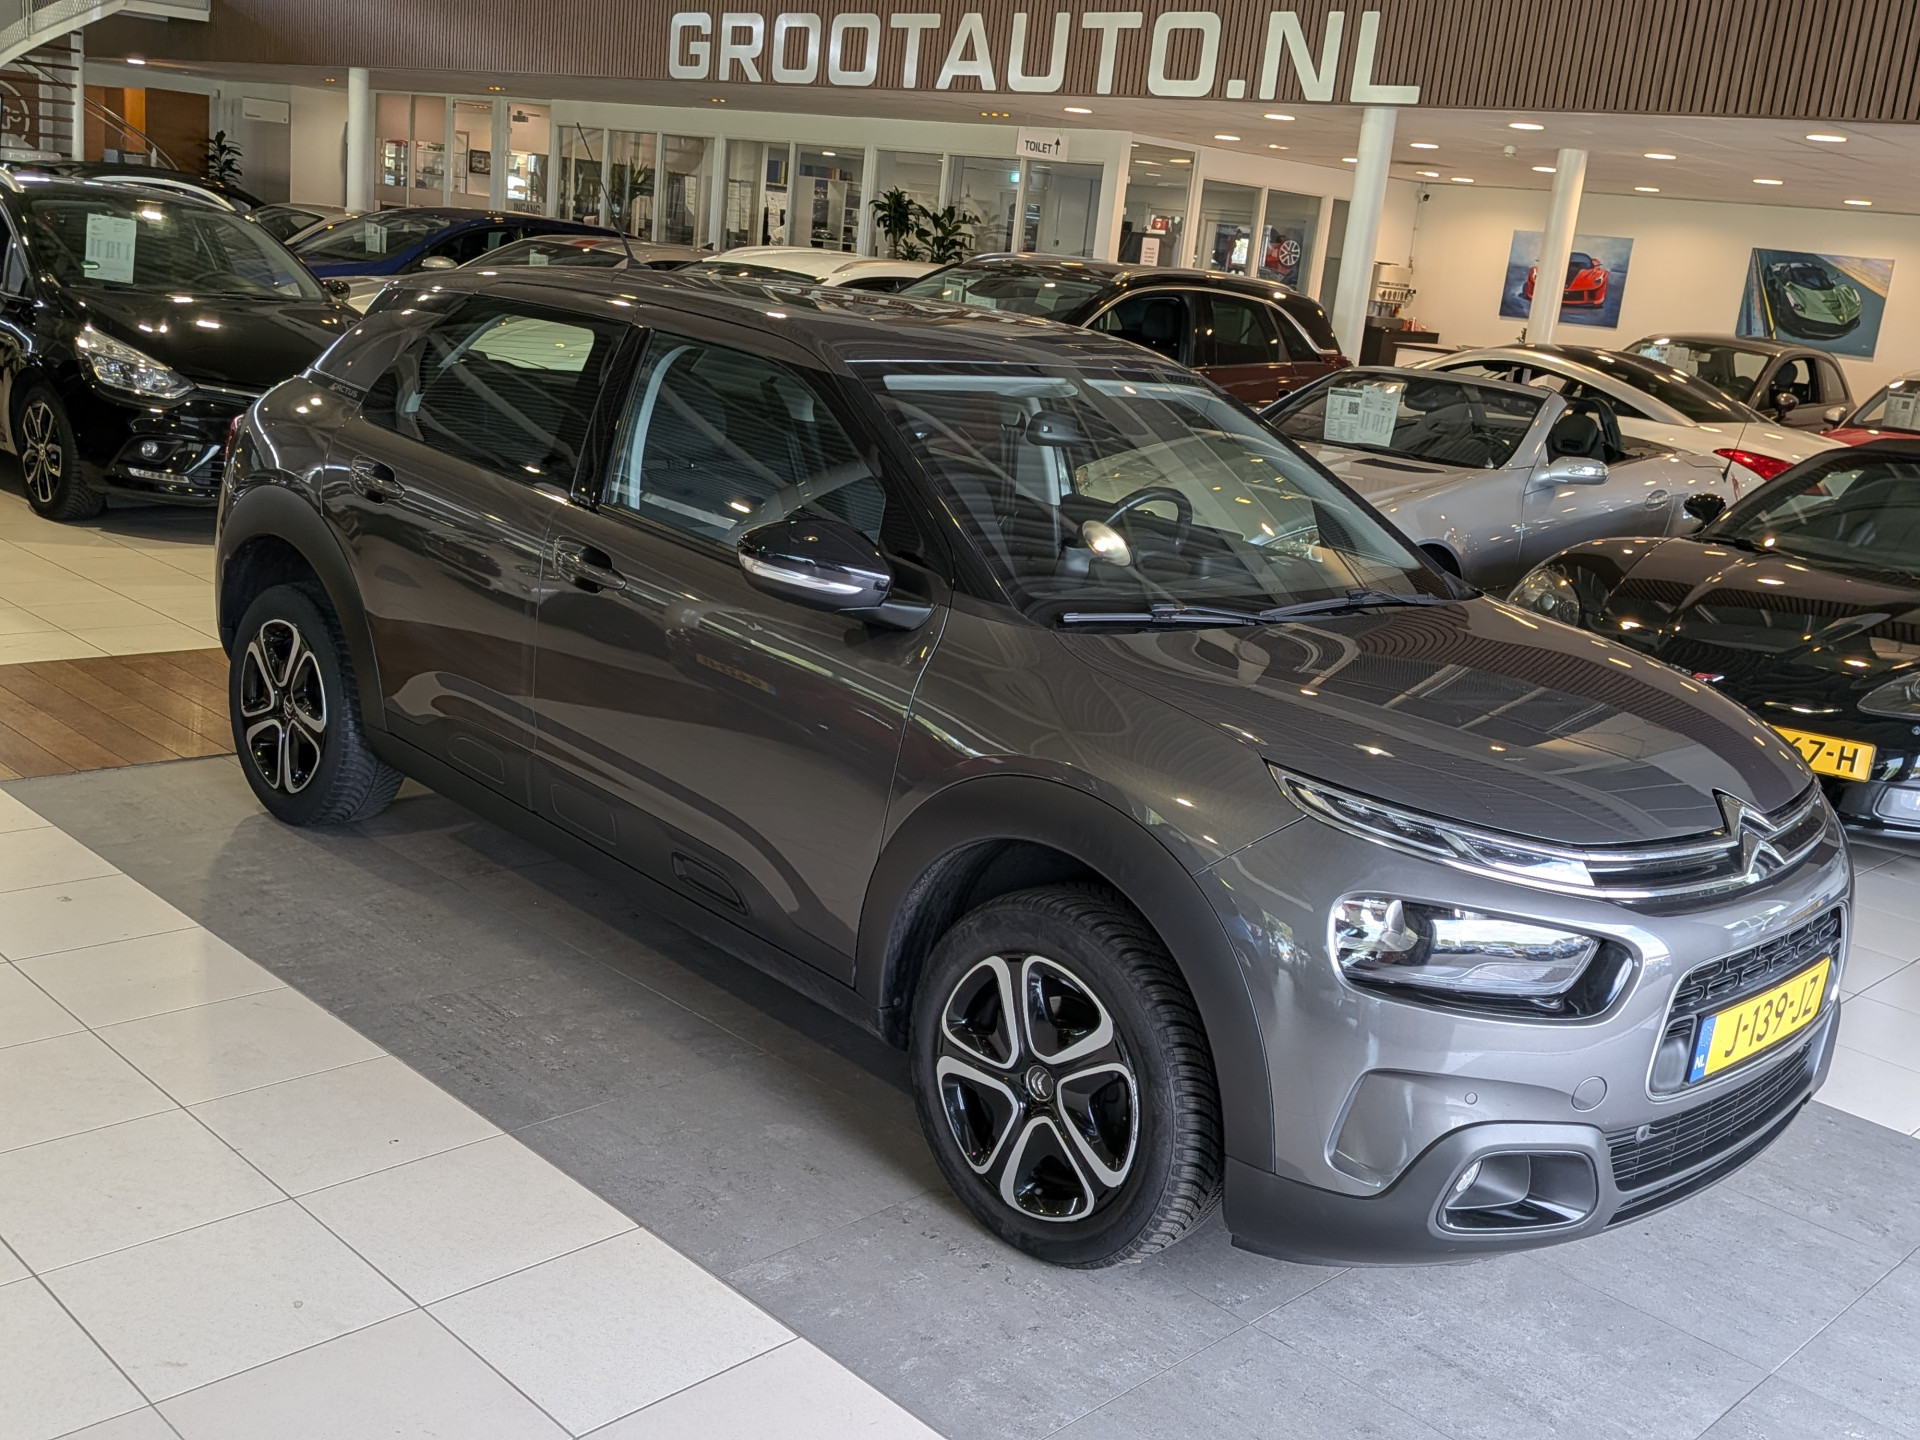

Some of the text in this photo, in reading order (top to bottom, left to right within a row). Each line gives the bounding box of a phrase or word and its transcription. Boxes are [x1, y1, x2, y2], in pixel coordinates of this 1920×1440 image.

[668, 11, 1420, 104] GROOTAUTO.NL
[1024, 139, 1053, 154] TOILET
[513, 202, 541, 215] INGANG
[330, 382, 358, 398] CACTUS
[1723, 974, 1819, 1058] J-139-JZ
[1694, 1054, 1705, 1070] NL
